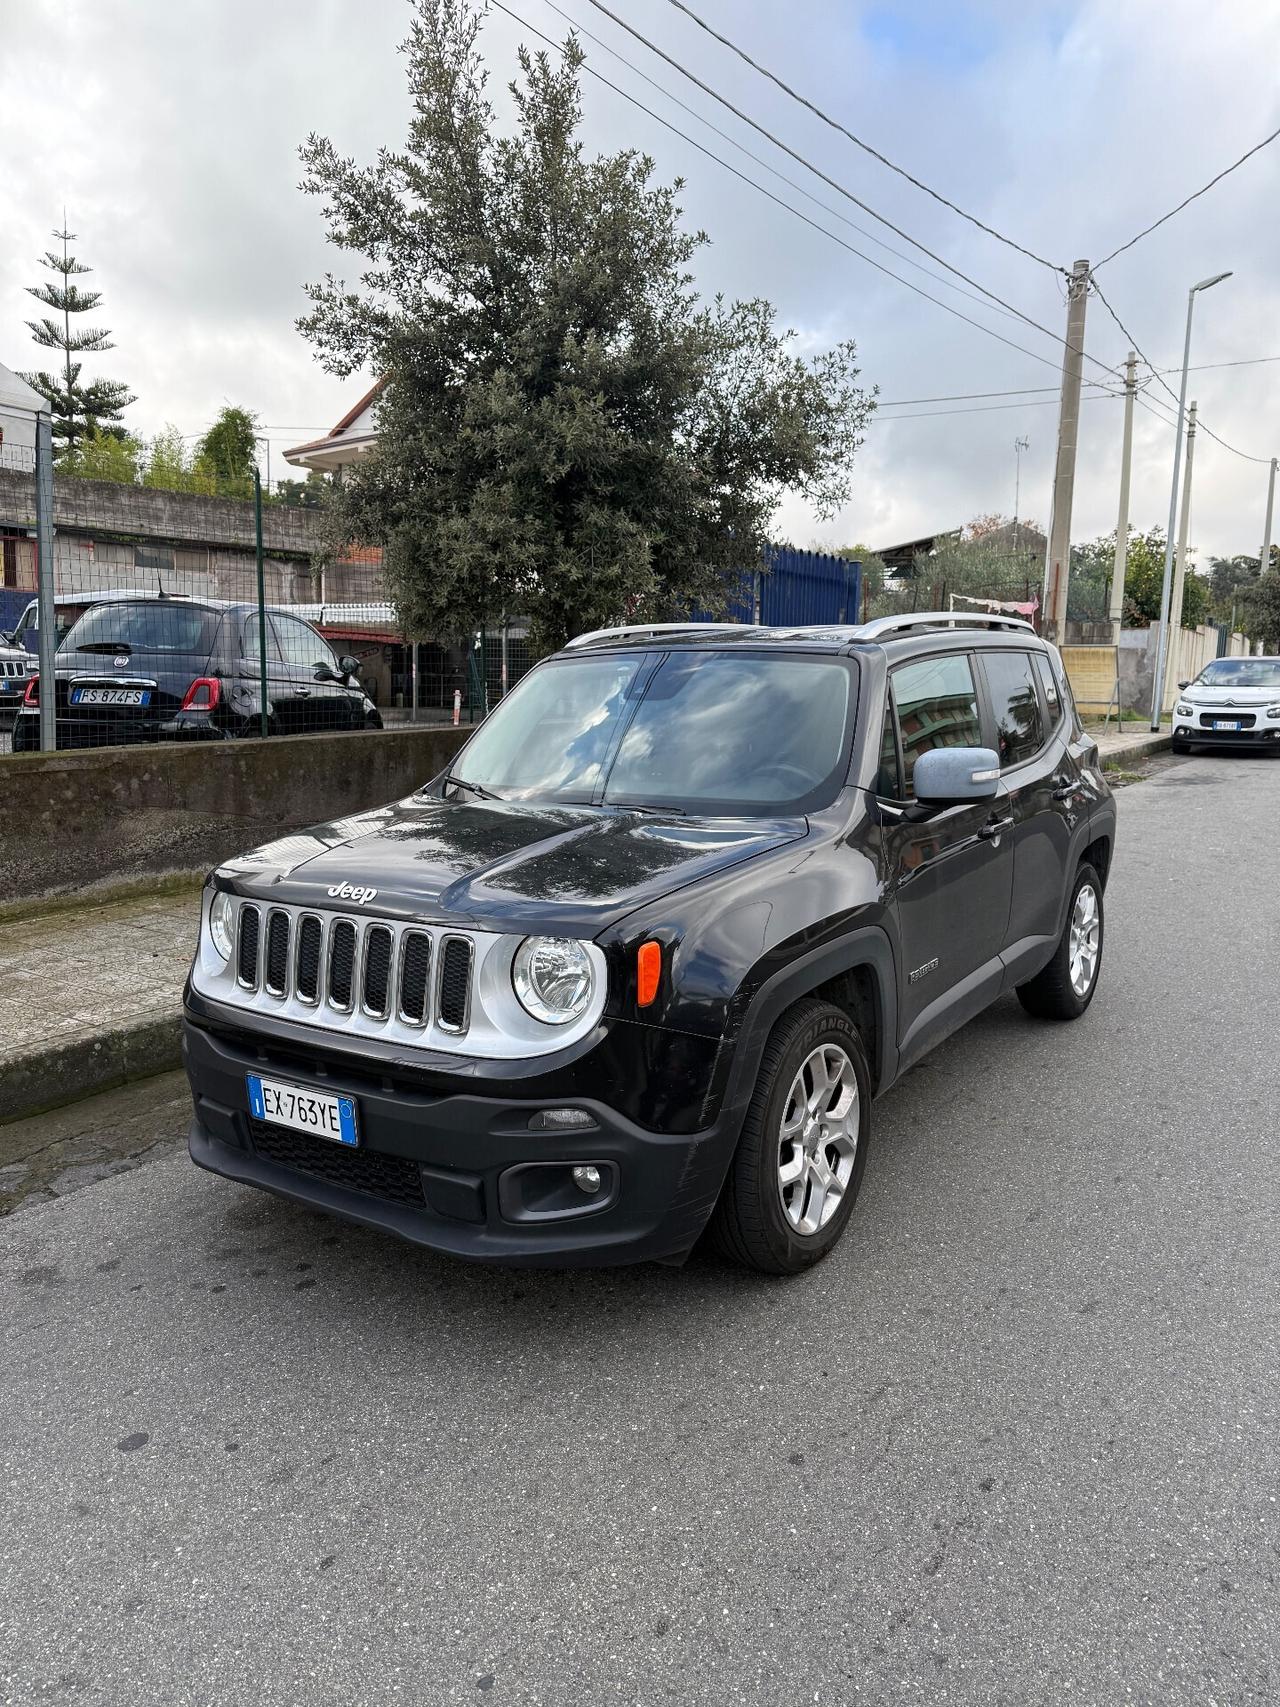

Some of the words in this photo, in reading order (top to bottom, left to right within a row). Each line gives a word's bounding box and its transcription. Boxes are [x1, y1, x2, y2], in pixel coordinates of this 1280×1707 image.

[81, 690, 98, 702] FS
[101, 690, 141, 703] 874FS
[328, 880, 378, 905] Jeep
[255, 1098, 260, 1114] I
[263, 1087, 284, 1117] EX
[287, 1093, 340, 1132] 763YE
